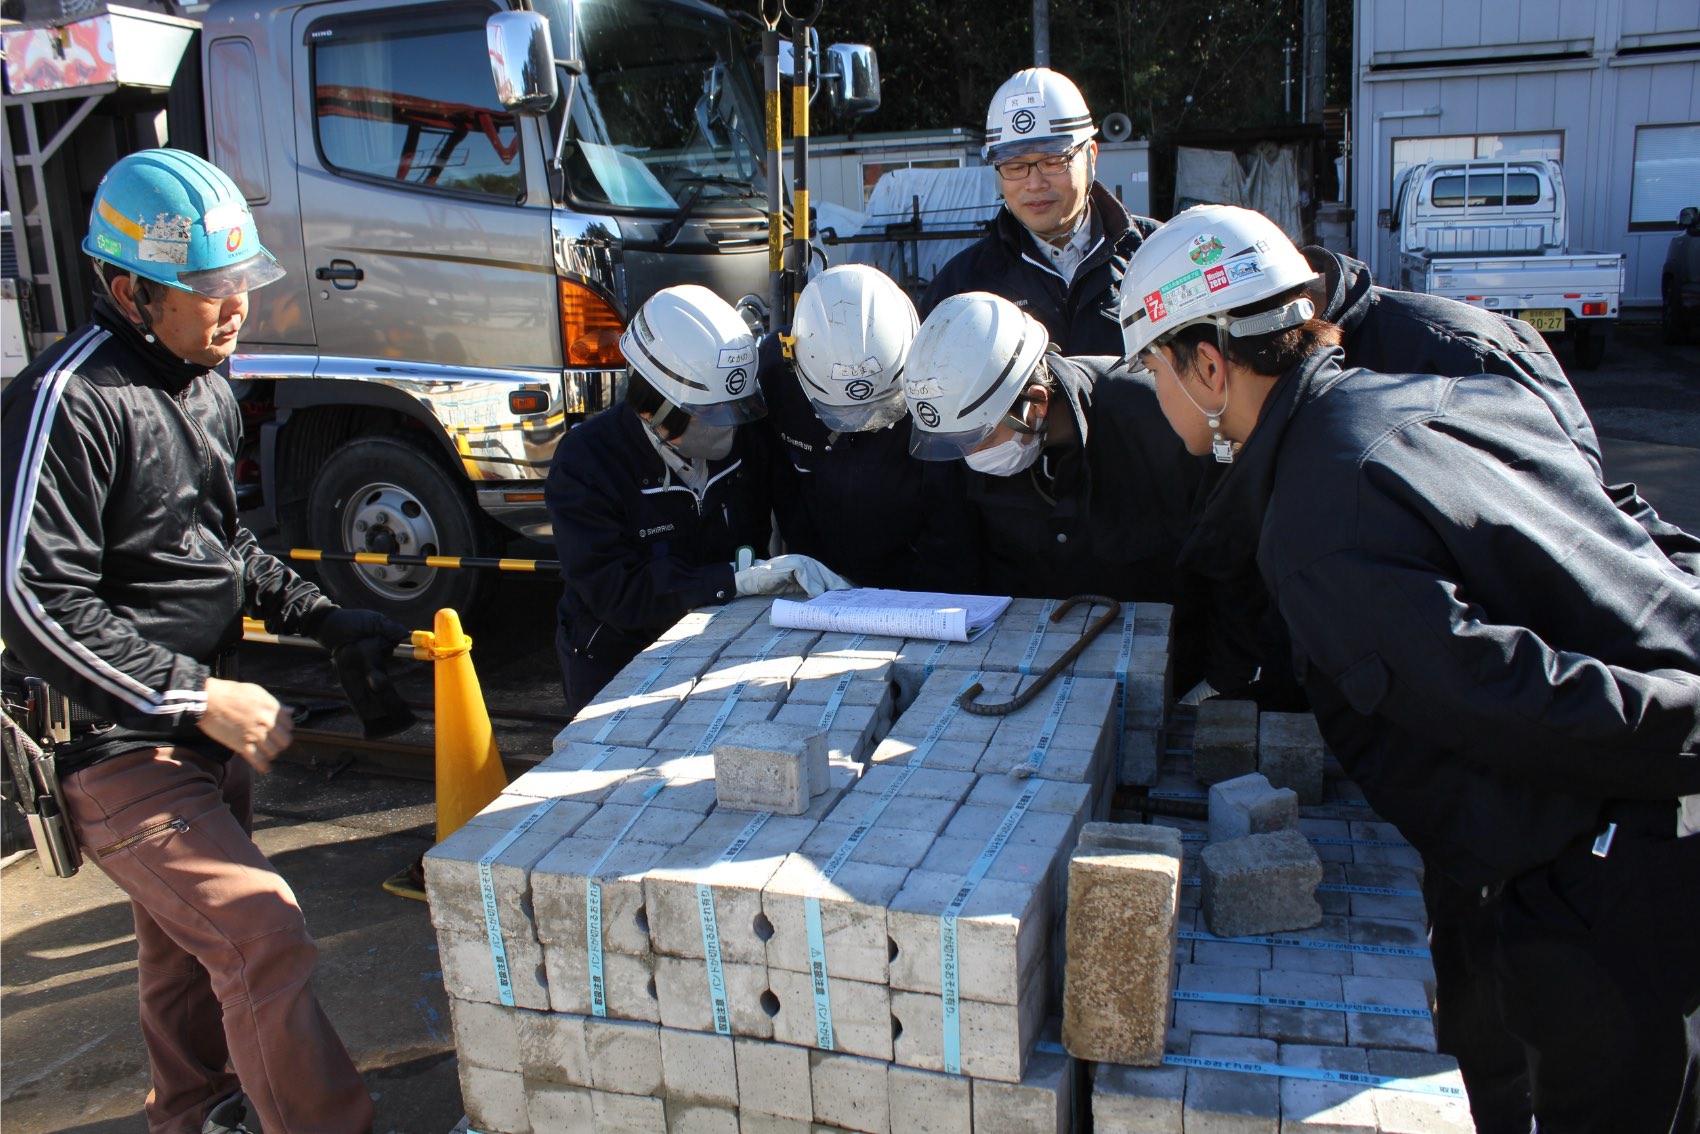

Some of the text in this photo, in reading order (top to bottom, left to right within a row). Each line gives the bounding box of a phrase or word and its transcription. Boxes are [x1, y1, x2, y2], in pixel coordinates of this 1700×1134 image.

[1206, 270, 1225, 282] Mission
[1209, 276, 1227, 289] zero
[496, 955, 510, 987] 取扱注意
[813, 961, 826, 996] 取扱注意
[593, 975, 604, 1005] 取扱注意
[715, 999, 728, 1031] 取扱注意
